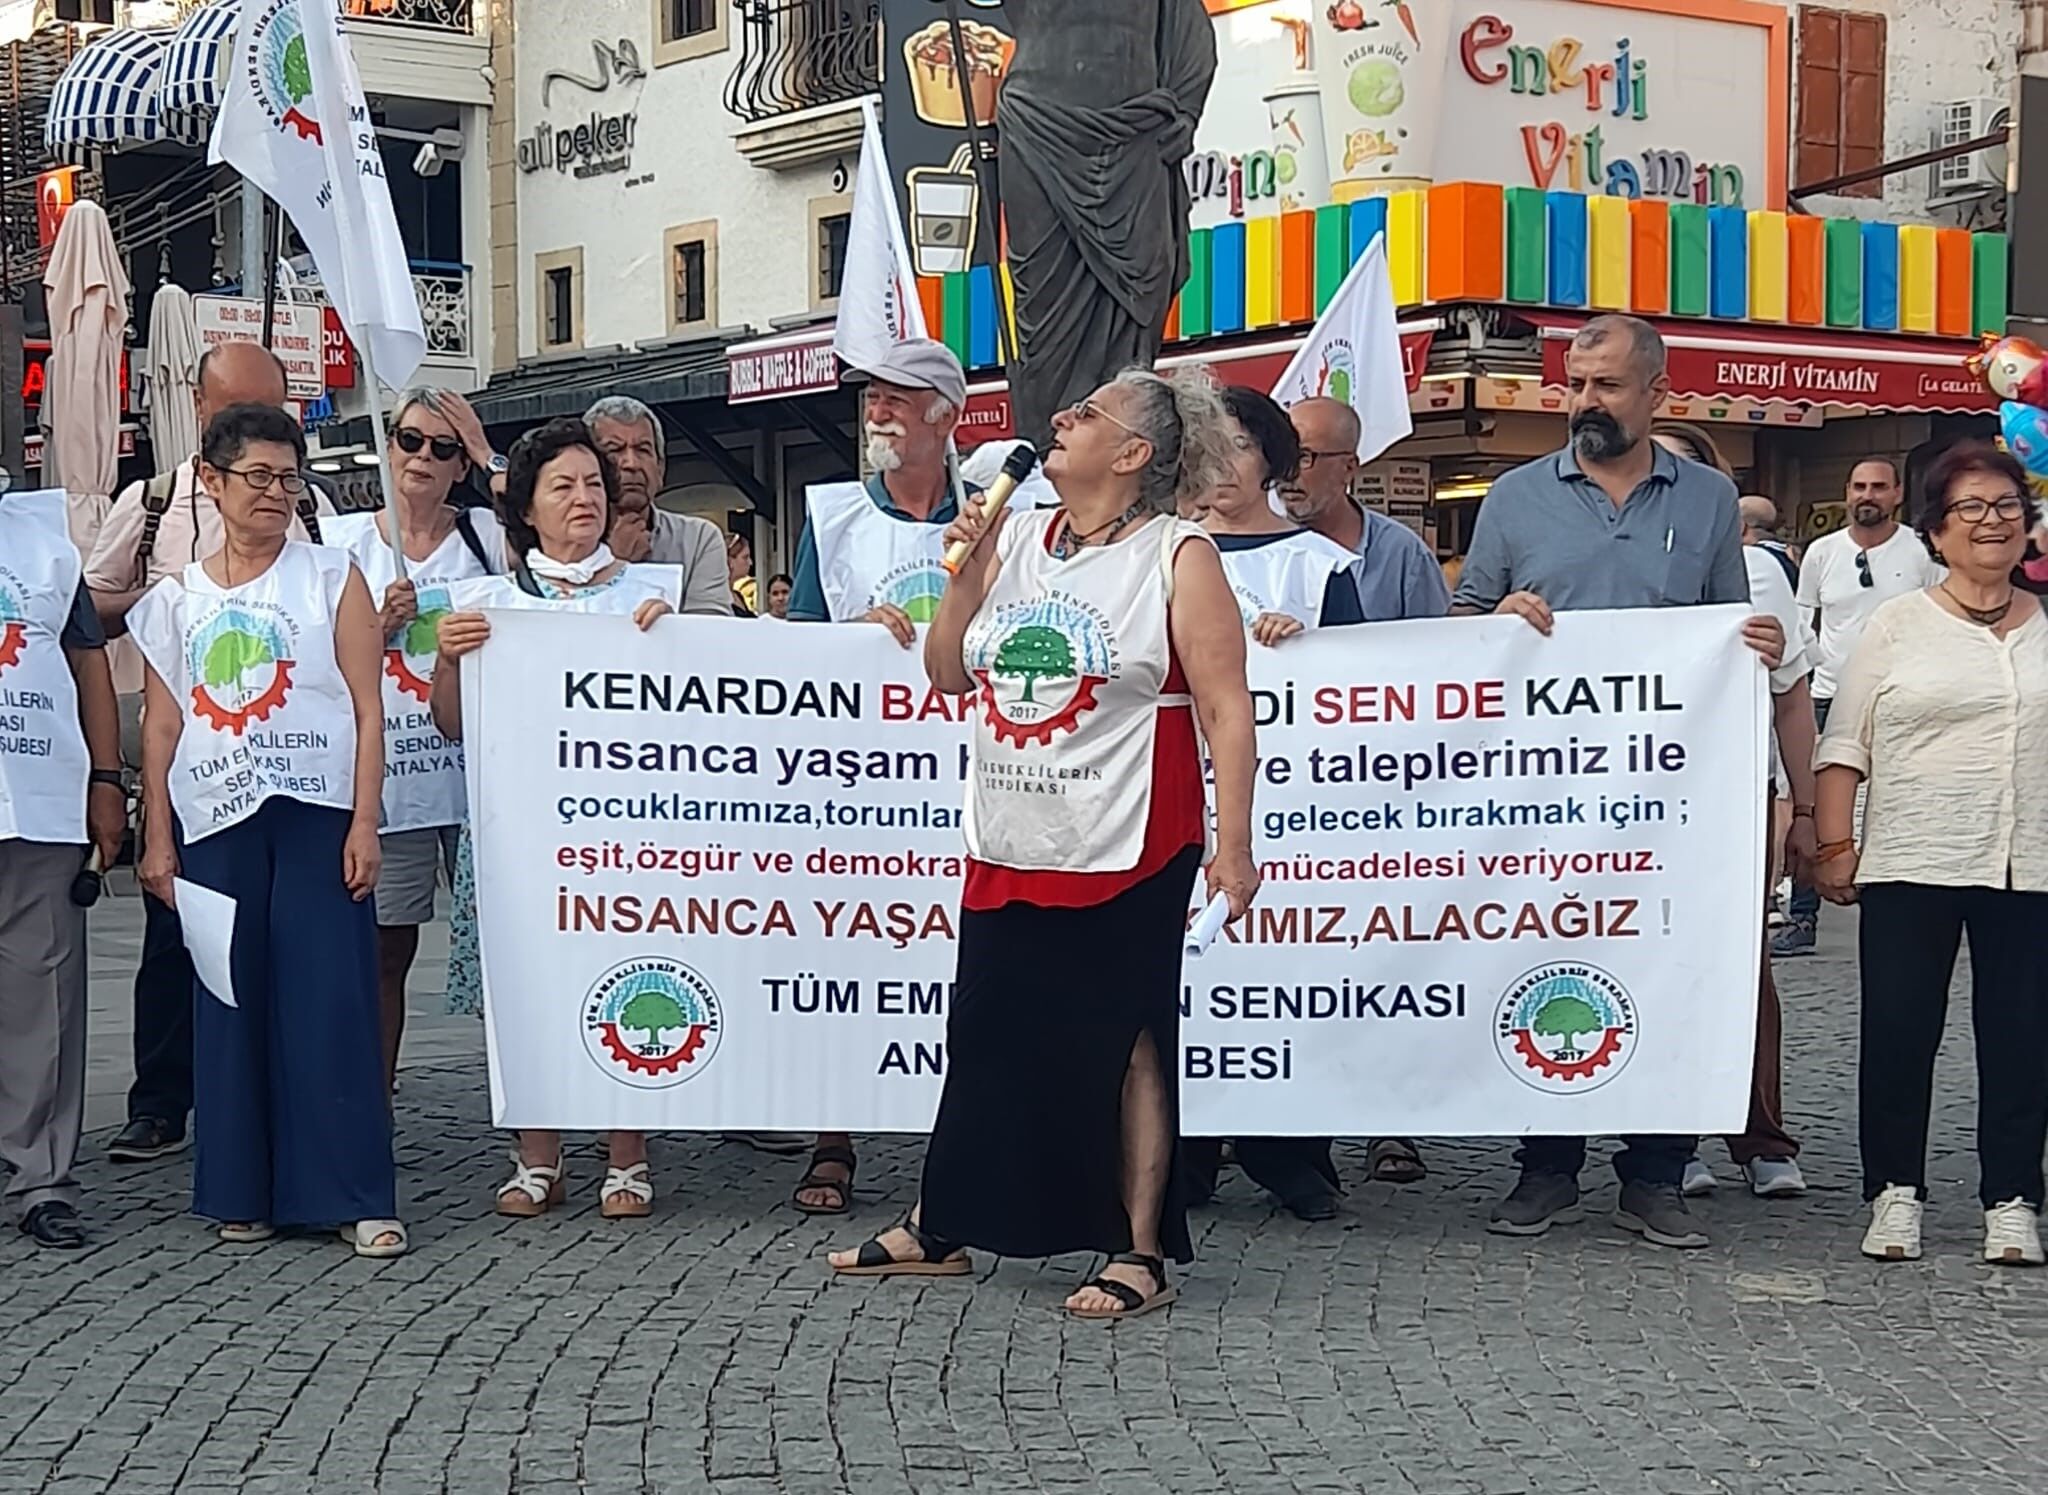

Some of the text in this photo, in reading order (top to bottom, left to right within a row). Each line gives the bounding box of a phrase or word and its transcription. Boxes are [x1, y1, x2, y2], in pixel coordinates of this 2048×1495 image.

[556, 112, 638, 174] peker
[731, 358, 762, 395] BUBBLE
[763, 354, 793, 390] WAFFLE
[802, 347, 836, 384] COFFEE
[1717, 360, 1880, 393] ENERJİ VİTAMİN
[563, 671, 862, 720] KENARDAN
[1313, 684, 1416, 726] SEN
[1436, 679, 1505, 721] DE
[1526, 673, 1684, 717] KATIL
[1008, 705, 1039, 719] 2017
[189, 756, 230, 782] TÜM
[384, 755, 455, 779] NTALYA
[558, 730, 759, 775] insanca
[775, 746, 939, 788] yaşam
[1309, 736, 1609, 791] taleplerimiz
[1627, 733, 1687, 773] ile
[1263, 803, 1403, 840] gelecek
[1416, 799, 1587, 830] bırakmak
[1600, 794, 1665, 830] için
[557, 842, 742, 878] eşit,özgür
[752, 852, 794, 874] ve
[1260, 850, 1466, 881] mücadelesi
[1478, 848, 1664, 881] veriyoruz.
[557, 886, 798, 937] İNSANCA
[813, 901, 957, 949] YAŞA
[762, 972, 859, 1014] TÜM
[1209, 978, 1466, 1019] SENDİKASI
[638, 1044, 670, 1056] 2017
[1185, 1039, 1291, 1080] BESİ
[1552, 1050, 1585, 1061] 2017
